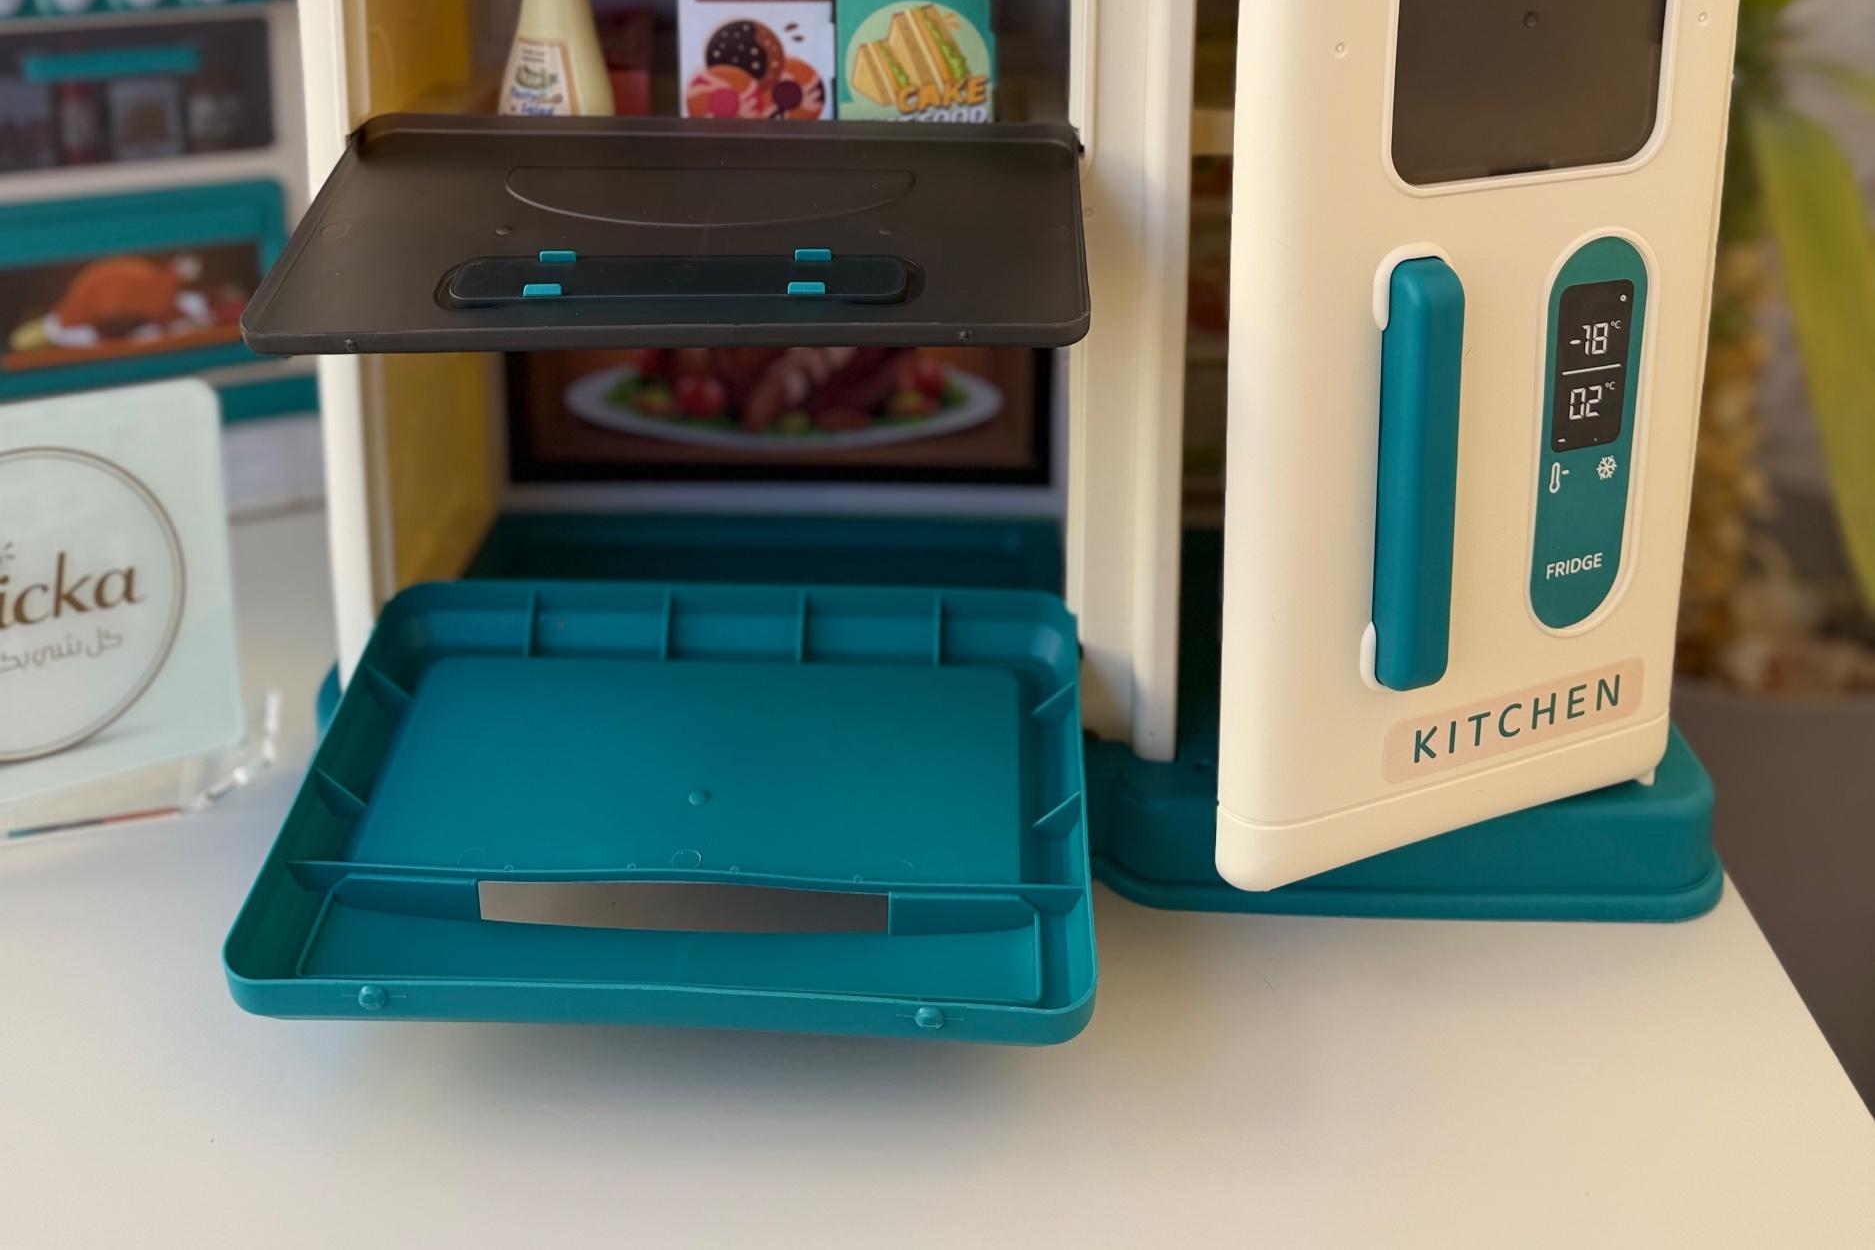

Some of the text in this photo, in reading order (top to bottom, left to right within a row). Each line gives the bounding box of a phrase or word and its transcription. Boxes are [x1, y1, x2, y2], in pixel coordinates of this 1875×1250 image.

[899, 78, 987, 113] CAKE
[1546, 552, 1603, 580] FRIDGE
[1413, 673, 1621, 763] KITCHEN
